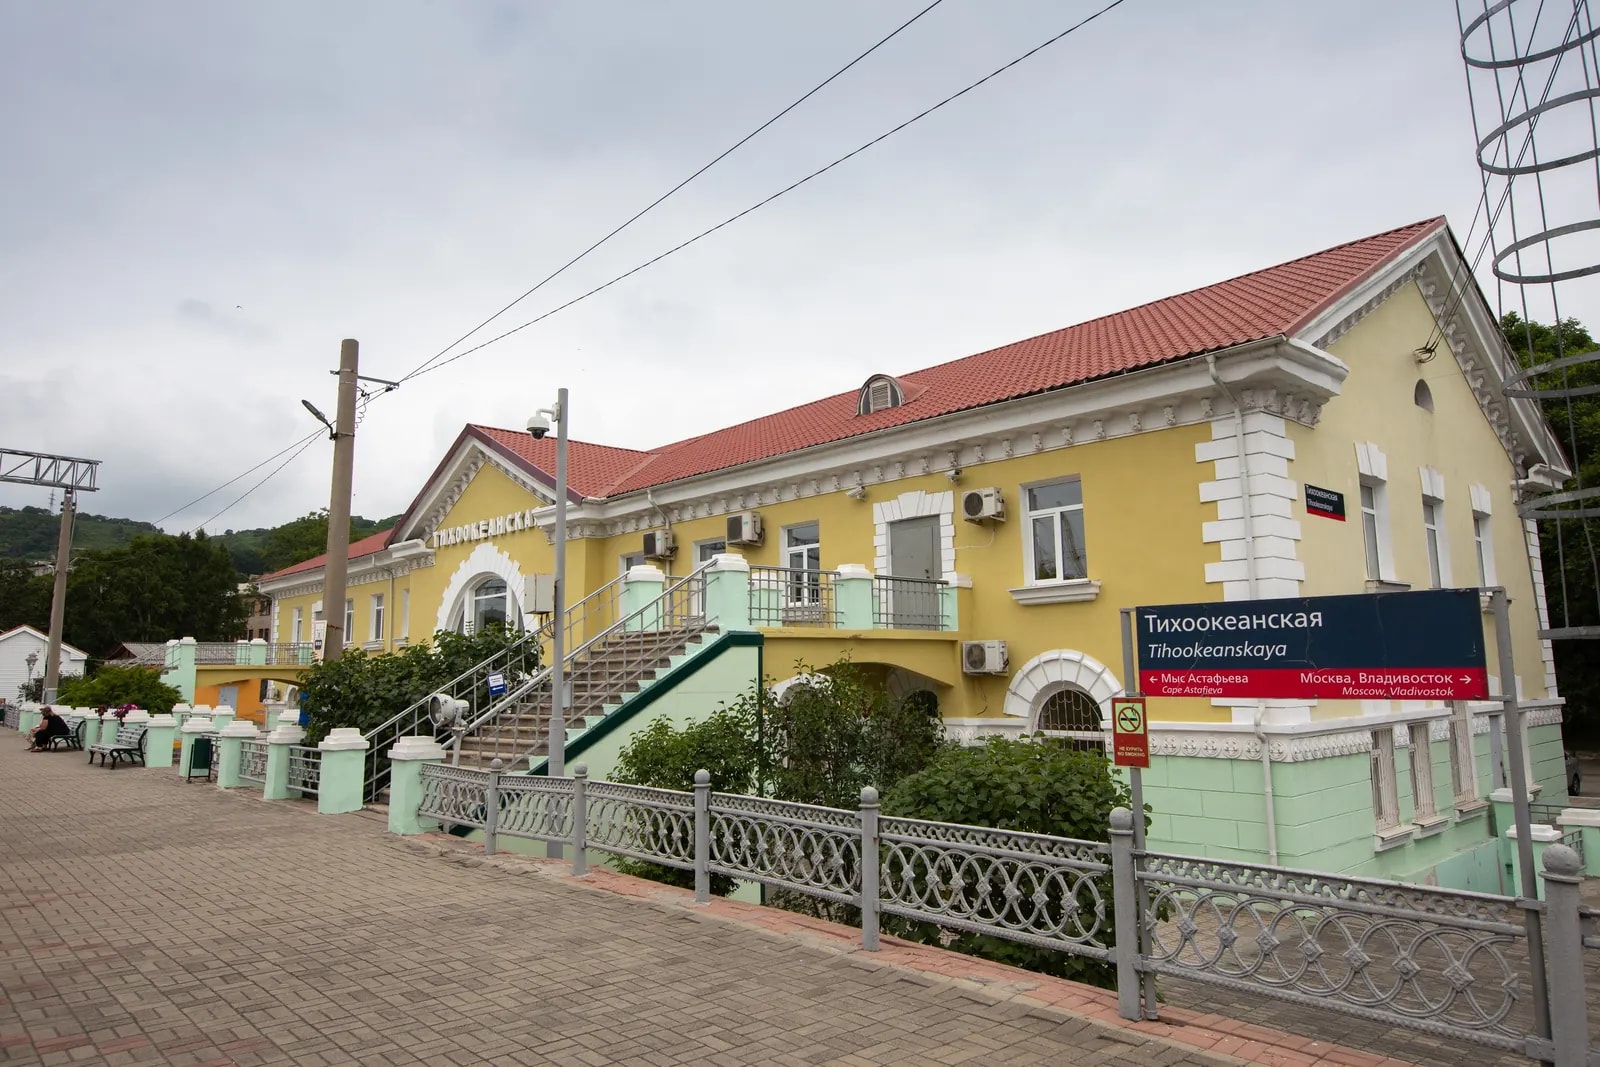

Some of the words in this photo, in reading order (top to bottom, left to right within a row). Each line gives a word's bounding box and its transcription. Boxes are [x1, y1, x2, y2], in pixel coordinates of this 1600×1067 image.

[1144, 612, 1322, 633] Тихоокеанская
[1148, 641, 1287, 661] Tihookeanskaya
[1161, 673, 1186, 684] Мыс
[1187, 673, 1249, 686] Астафьева
[1300, 672, 1355, 685] Москва,
[1358, 672, 1454, 685] Владивосток
[1162, 685, 1183, 695] Cape
[1183, 685, 1223, 695] Astafieva
[1341, 686, 1387, 697] Moscow,
[1389, 686, 1454, 697] Vladivostok
